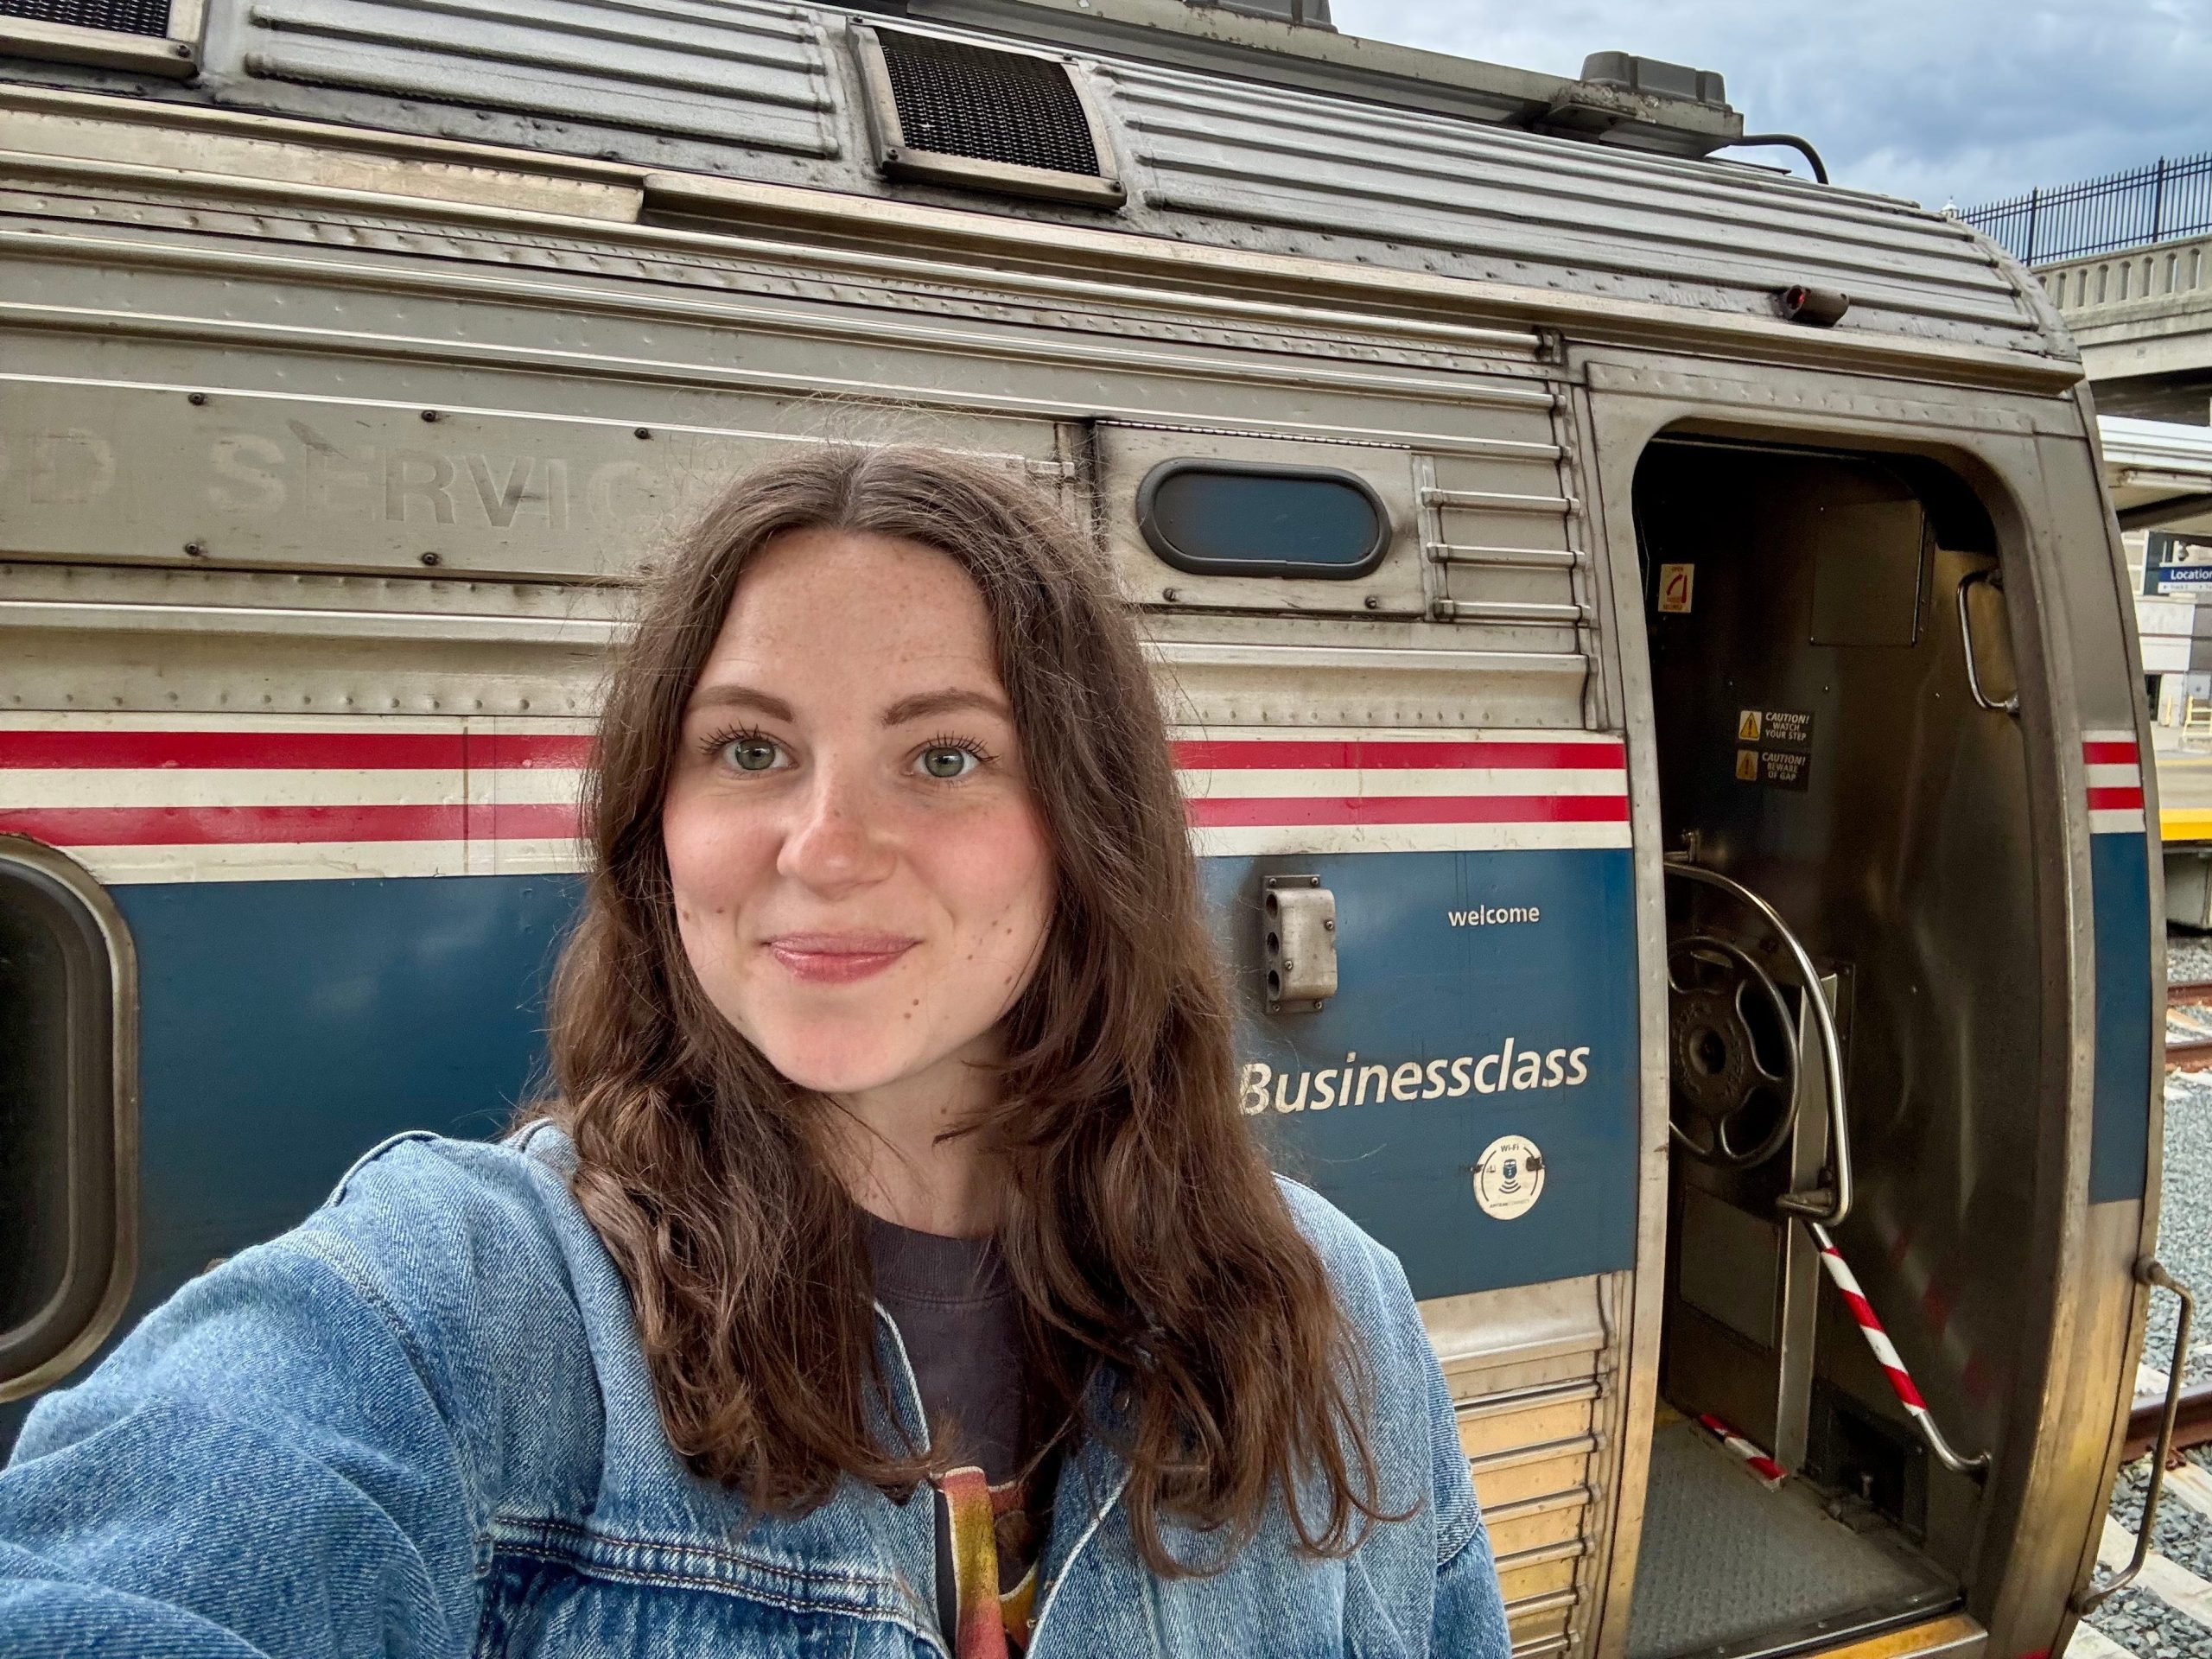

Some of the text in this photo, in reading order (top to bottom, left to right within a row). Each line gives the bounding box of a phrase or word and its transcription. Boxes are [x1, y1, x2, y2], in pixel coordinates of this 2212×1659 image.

[208, 432, 704, 534] SERVIC
[1765, 712, 1810, 724] CAUTION!
[1772, 721, 1800, 732] WATCH
[1765, 729, 1807, 741] YOUR STEP
[1762, 752, 1806, 766] CAUTION!
[1448, 905, 1540, 927] welcome
[1239, 1037, 1590, 1117] Businessclass
[1501, 1144, 1519, 1153] Wi-Fi
